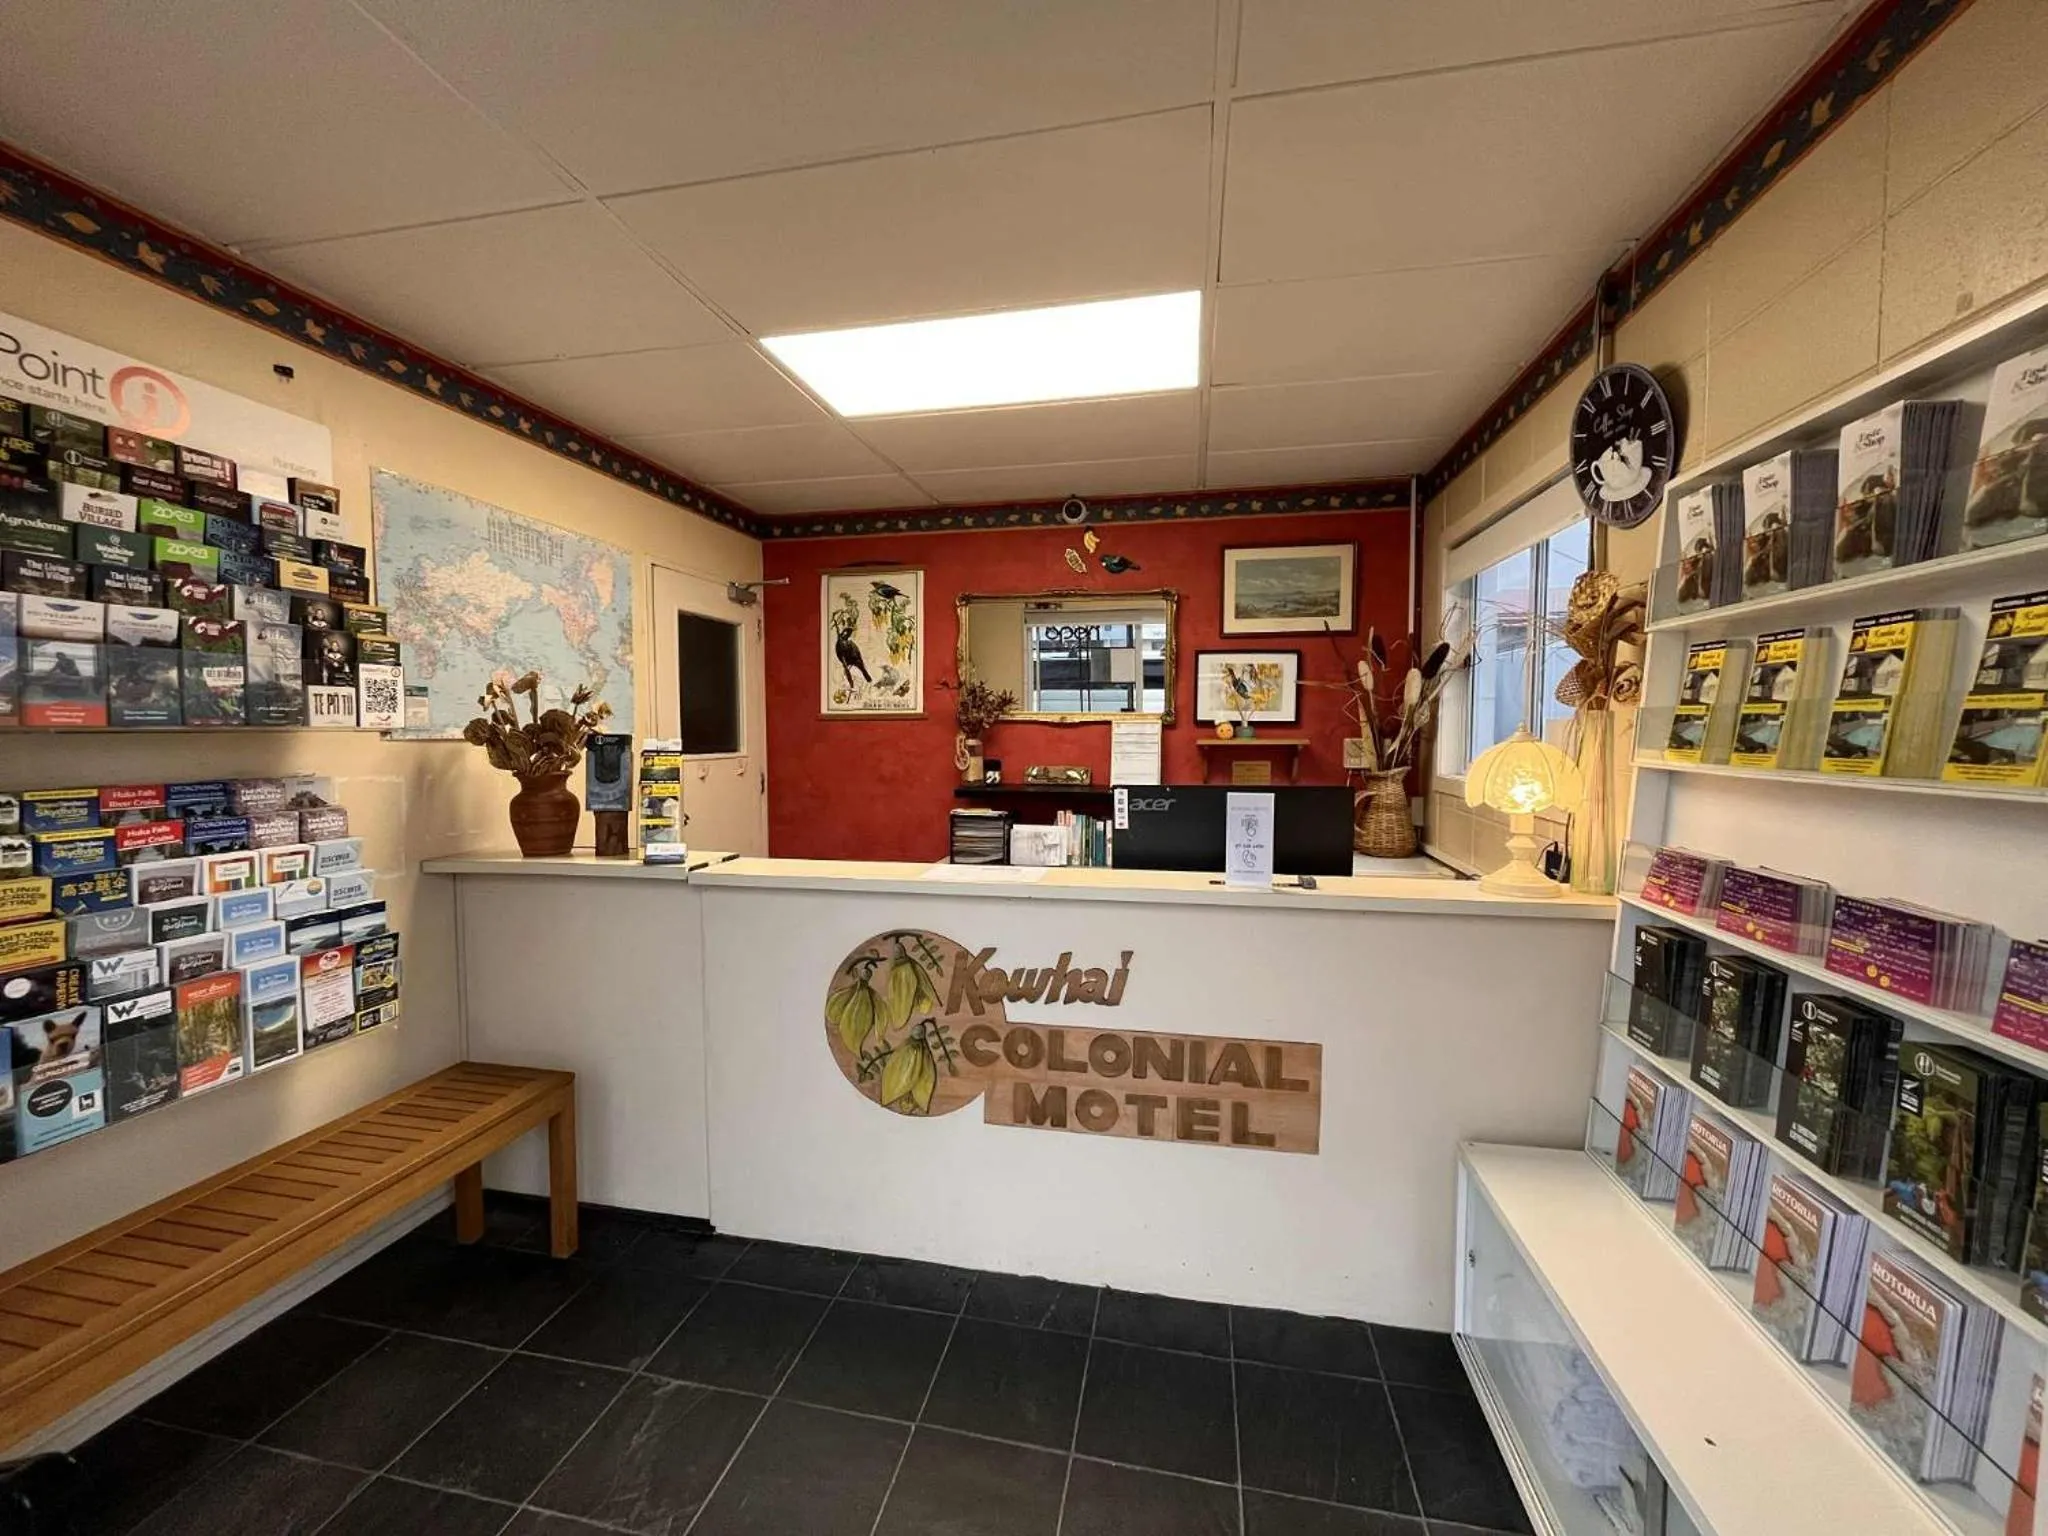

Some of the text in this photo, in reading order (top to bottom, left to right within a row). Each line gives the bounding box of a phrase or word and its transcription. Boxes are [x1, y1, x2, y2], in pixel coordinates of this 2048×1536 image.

[79, 511, 122, 528] VILLAGE
[82, 503, 123, 518] BURIED
[113, 789, 156, 799] Huka Falls
[1129, 797, 1176, 811] acer
[123, 838, 146, 847] River
[127, 826, 170, 838] Huka Falls
[944, 947, 1134, 1016] Kowhai
[958, 1023, 1310, 1092] COLONIAL
[1013, 1082, 1277, 1147] MOTEL
[1690, 1118, 1727, 1154] ROTORUA
[1771, 1182, 1819, 1227] ROTORUA
[1871, 1261, 1939, 1320] ROTORUA
